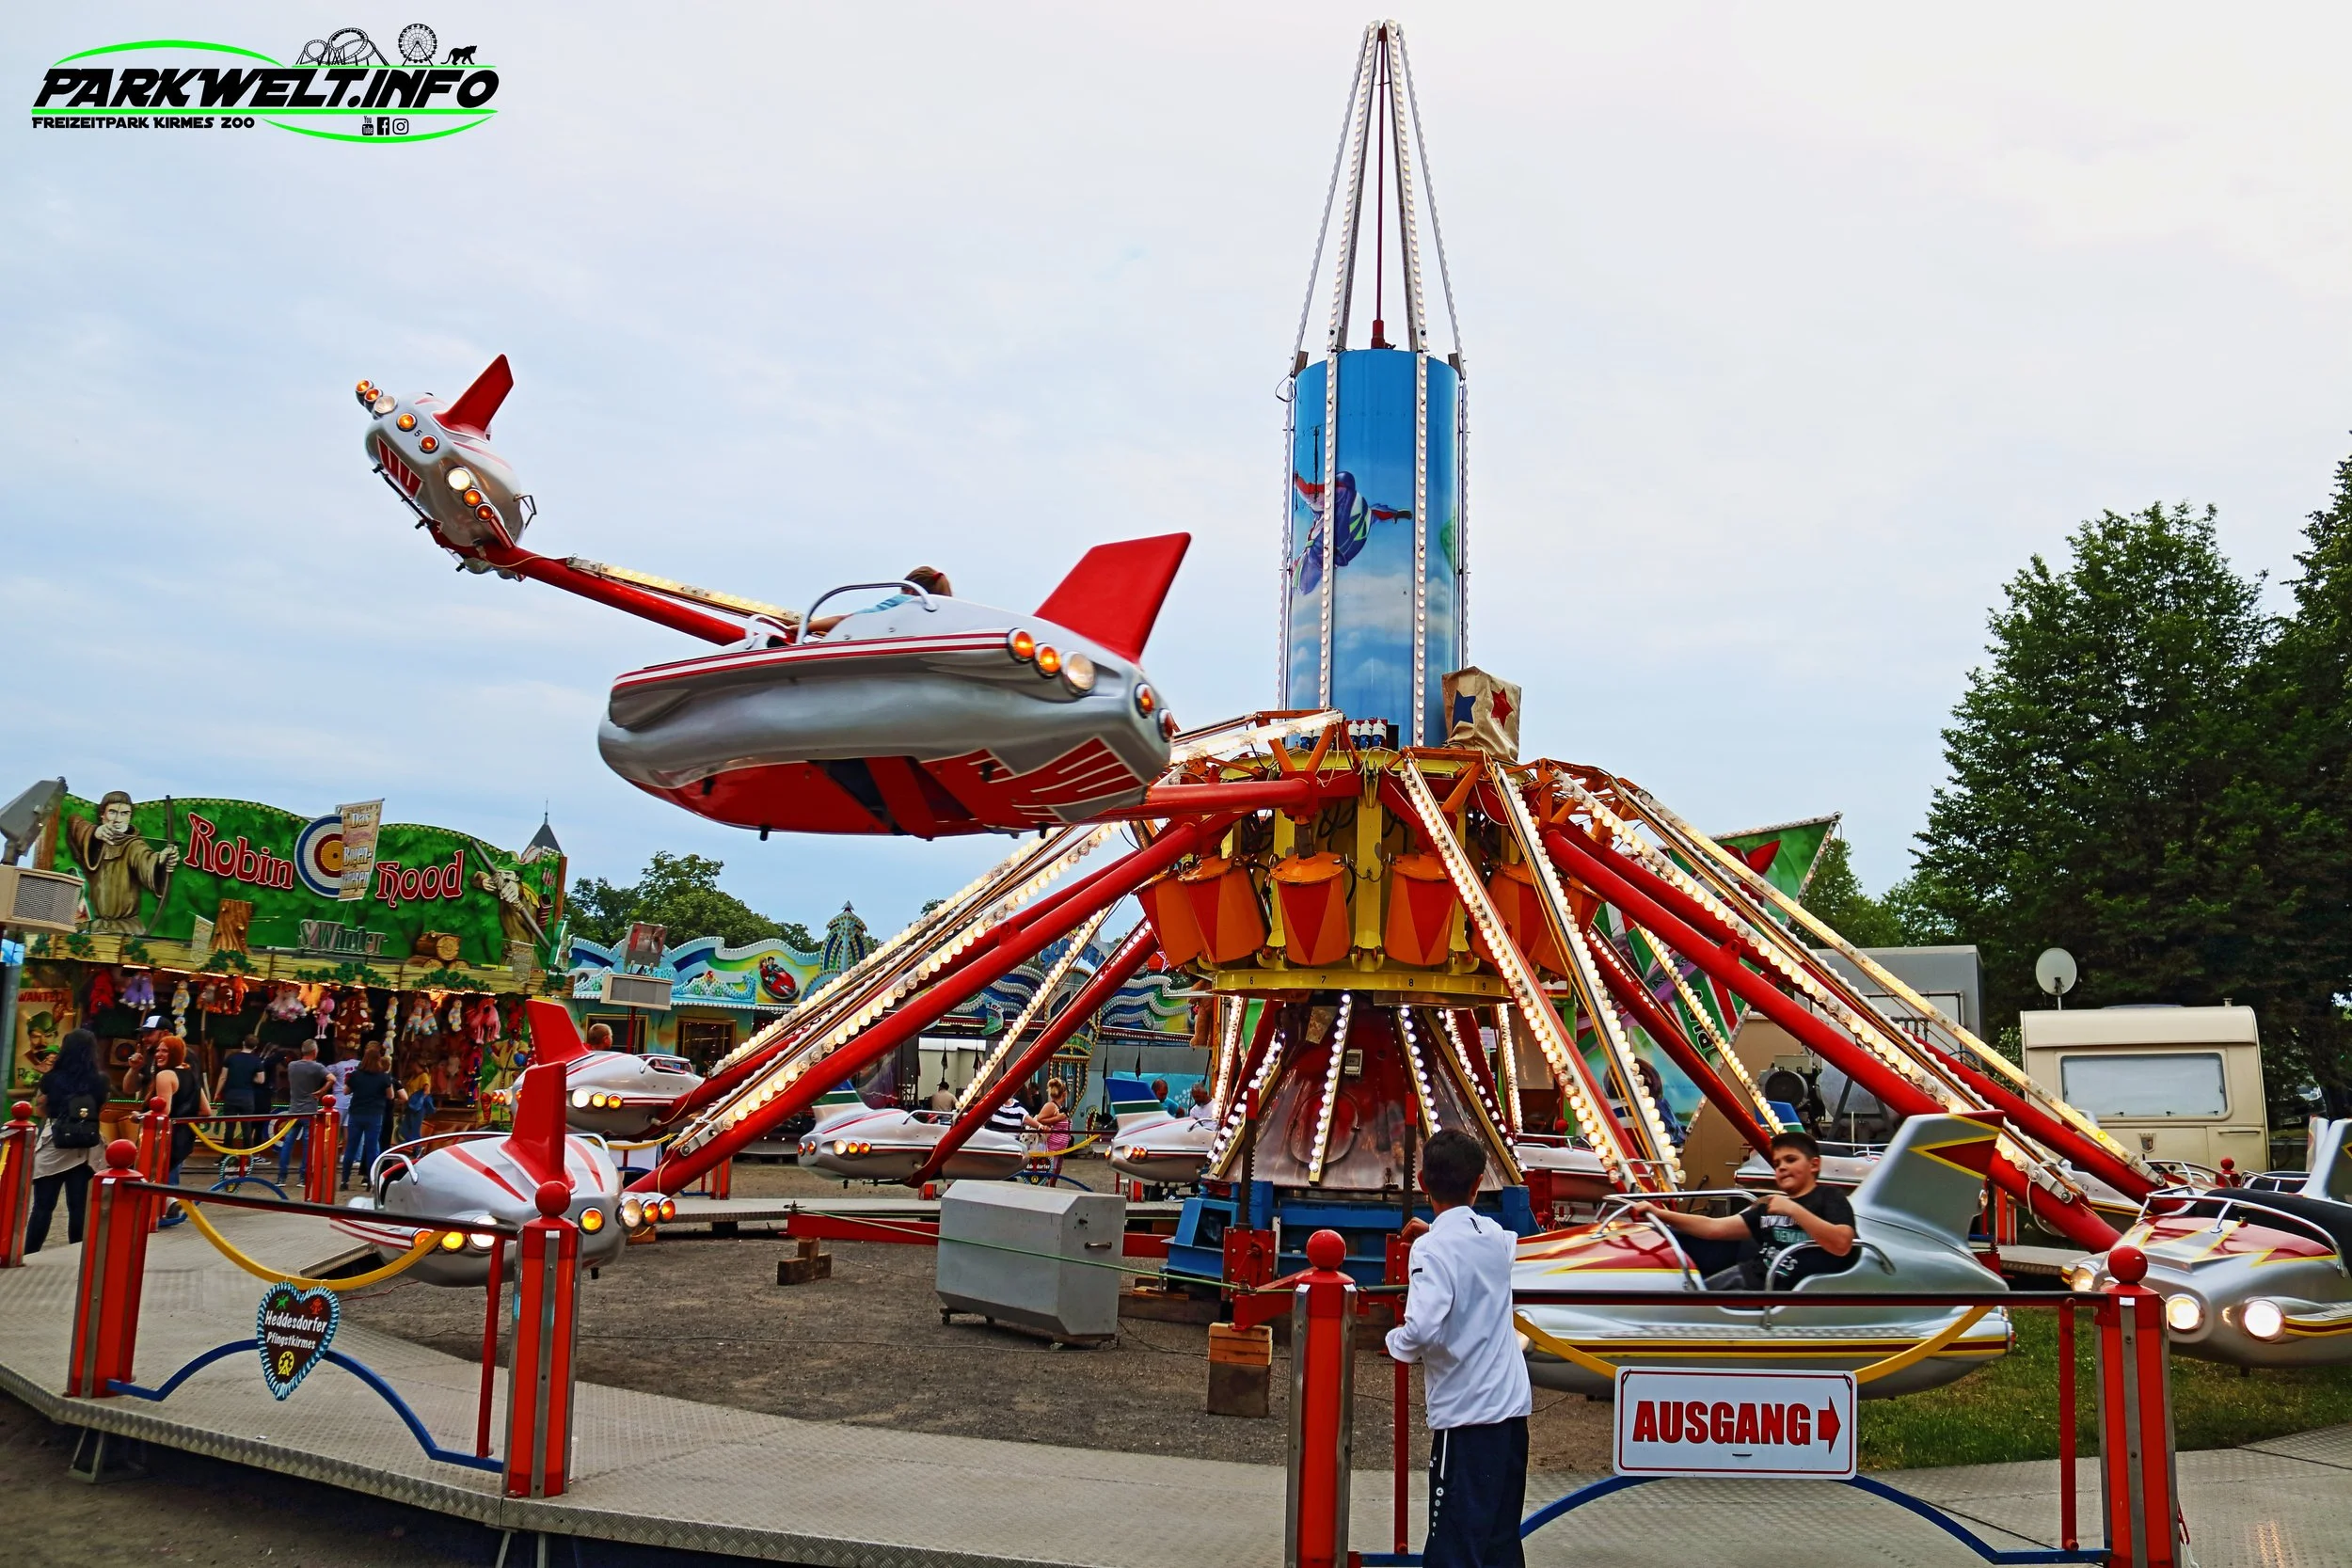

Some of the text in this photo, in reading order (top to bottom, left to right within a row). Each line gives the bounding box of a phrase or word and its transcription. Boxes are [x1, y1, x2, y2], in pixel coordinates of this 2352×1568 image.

[414, 429, 422, 437] 5
[351, 813, 371, 829] Das
[183, 812, 465, 908] Robin Hood
[1321, 975, 1327, 984] 7
[1408, 978, 1414, 987] 8
[264, 1310, 328, 1333] Heddesdorfer
[266, 1331, 316, 1350] Pfingstkirmes
[1632, 1401, 1810, 1446] AUSGANG
